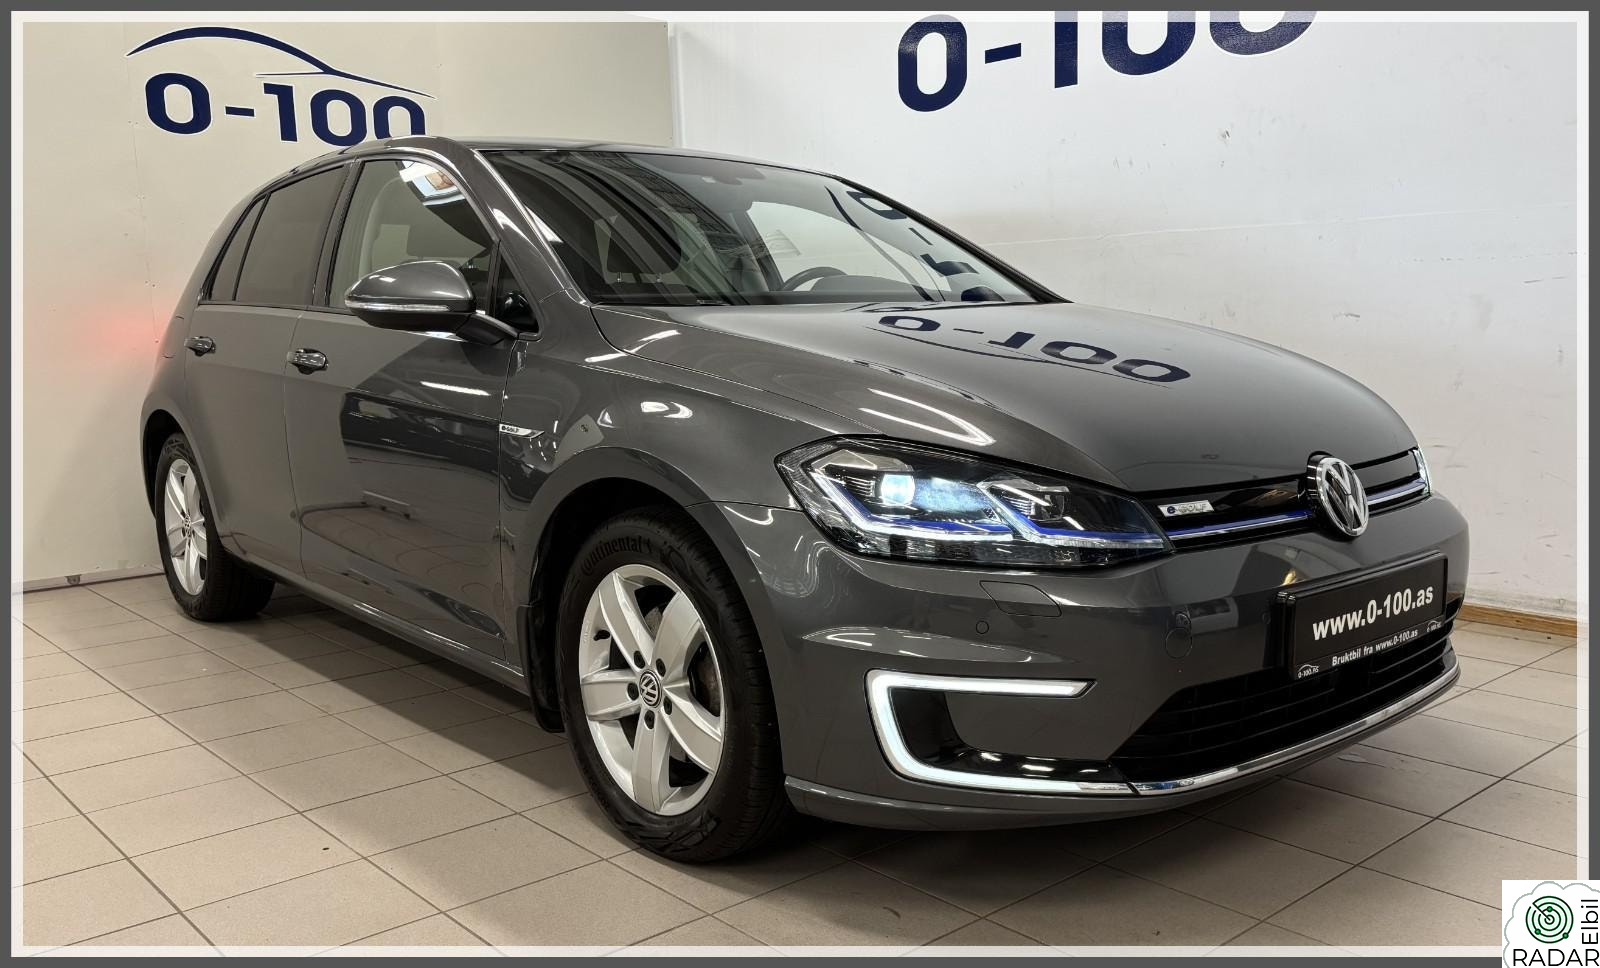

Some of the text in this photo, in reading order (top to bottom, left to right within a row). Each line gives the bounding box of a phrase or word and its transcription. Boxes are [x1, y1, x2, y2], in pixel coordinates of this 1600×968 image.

[145, 72, 426, 146] 0-100
[1312, 586, 1434, 641] www.0-100.as
[1332, 629, 1418, 667] Bruktbil fra www.0-100.as
